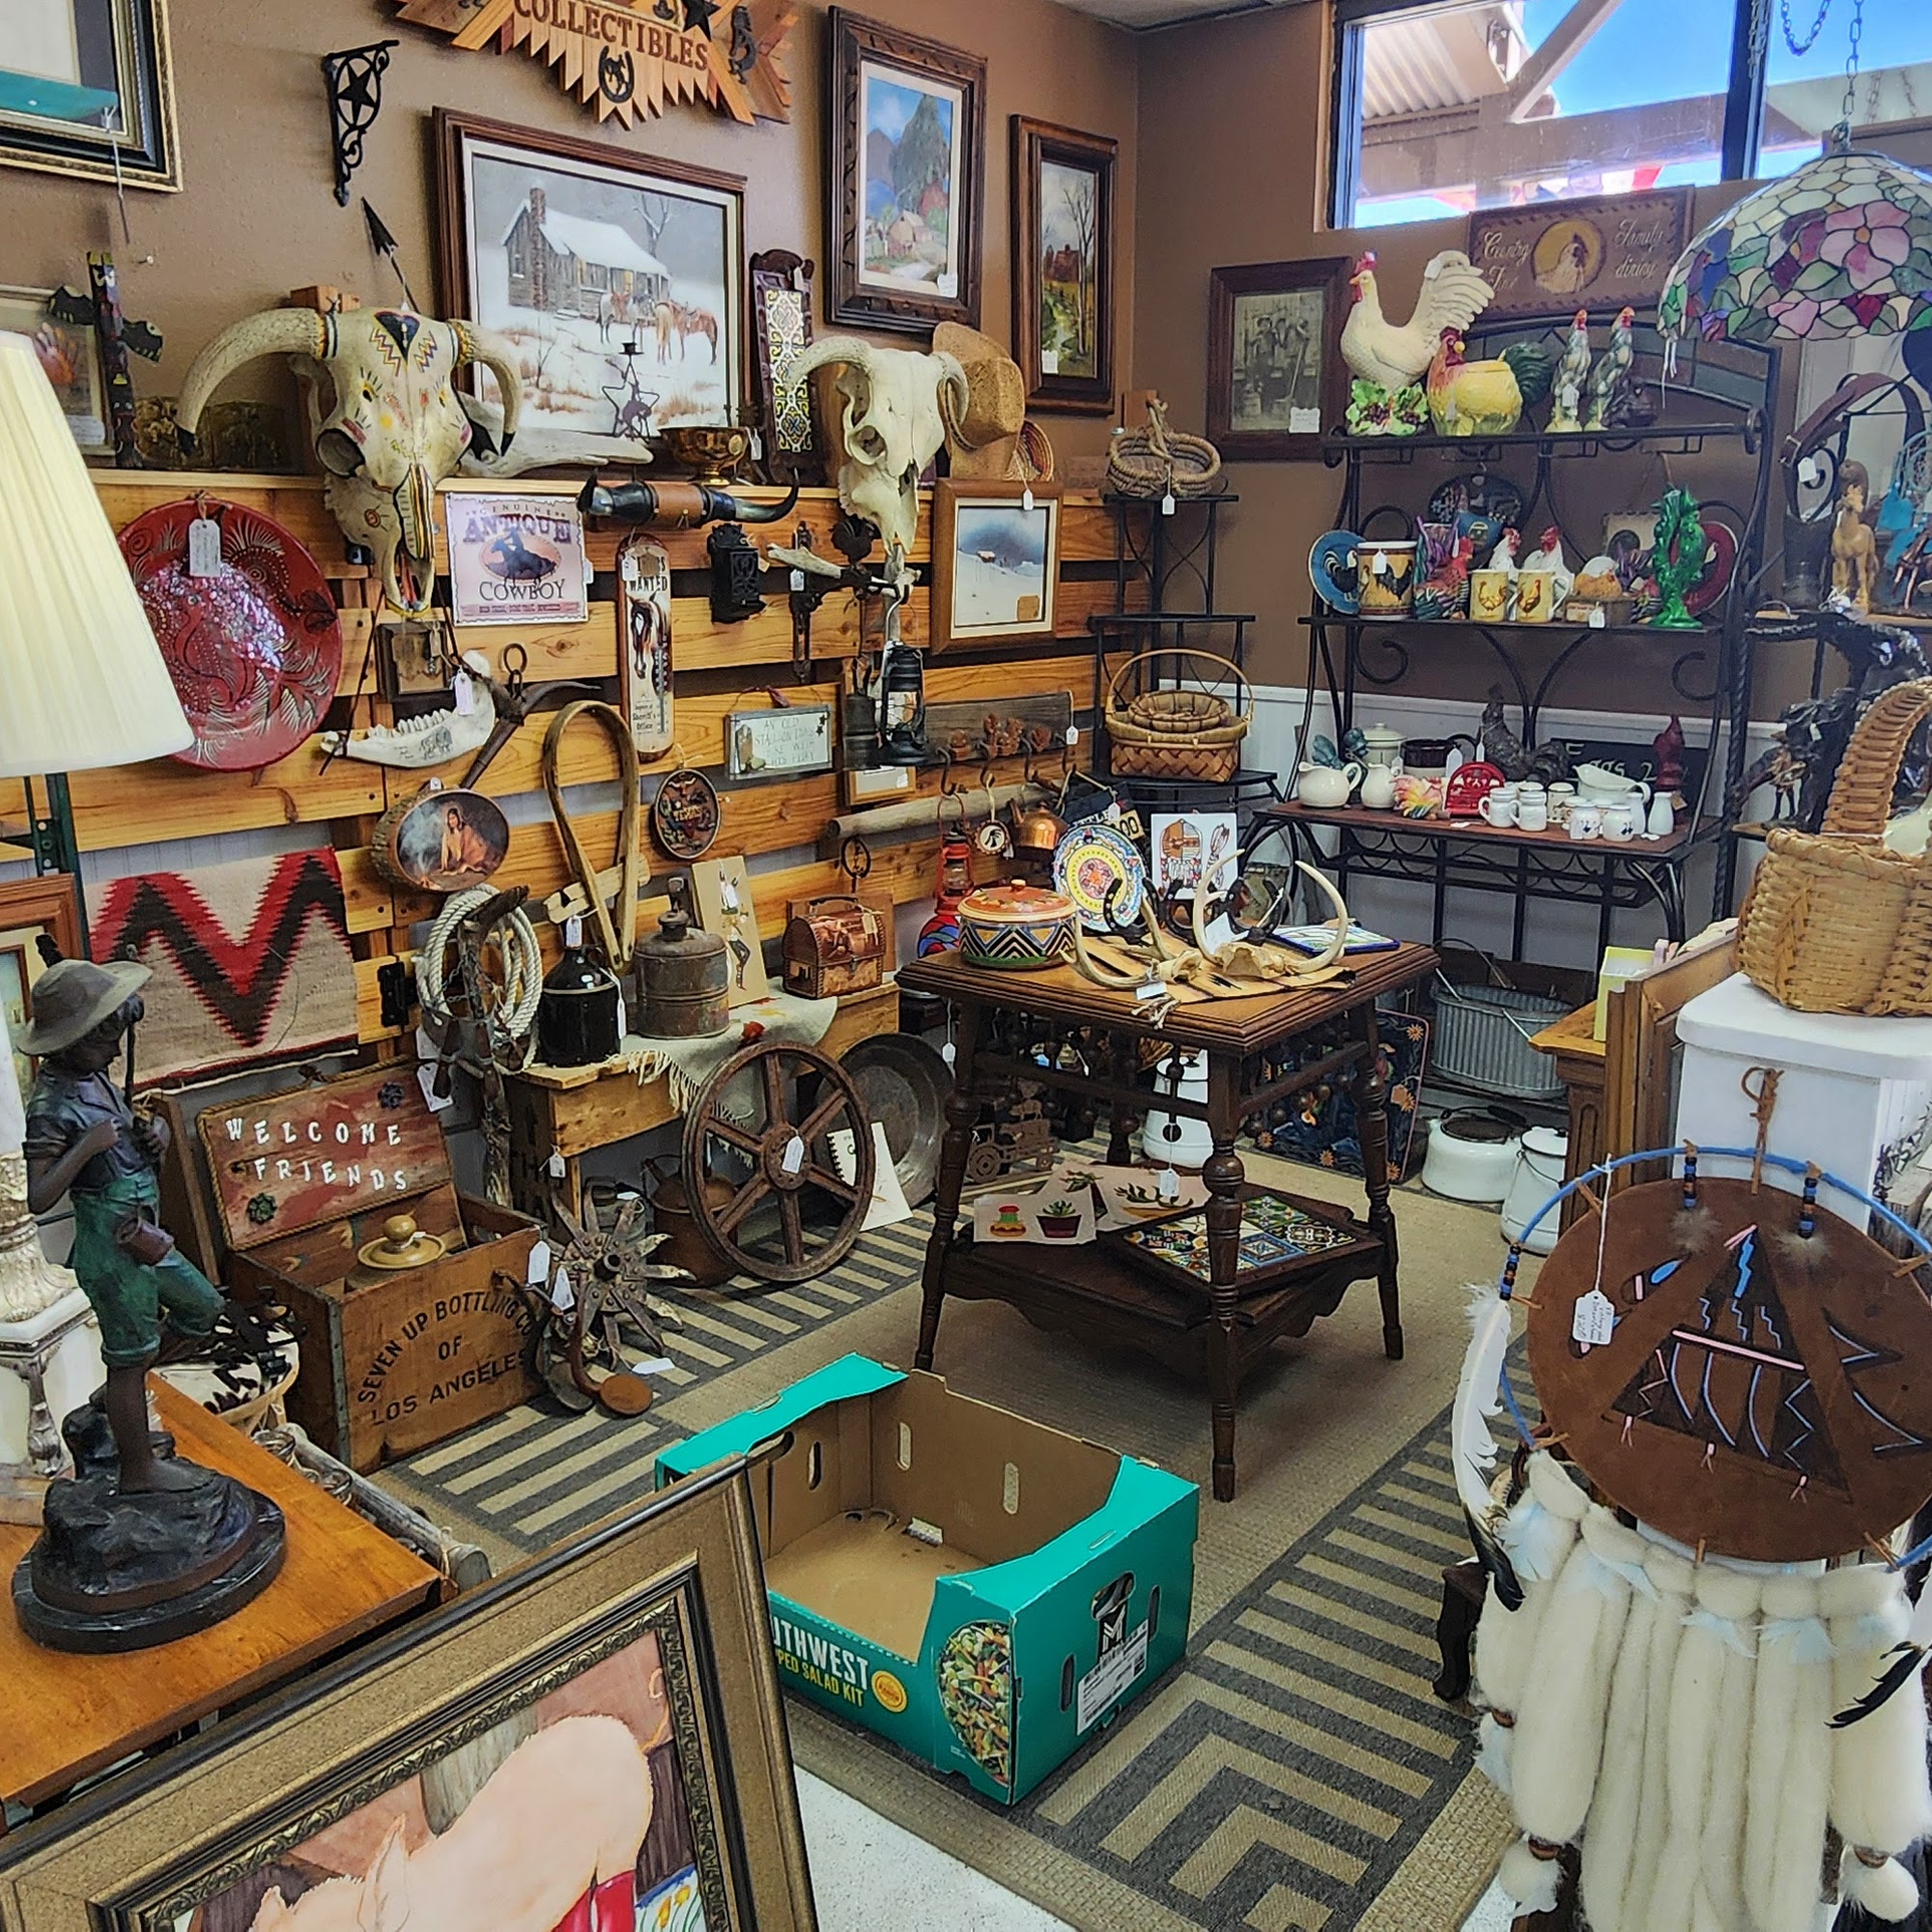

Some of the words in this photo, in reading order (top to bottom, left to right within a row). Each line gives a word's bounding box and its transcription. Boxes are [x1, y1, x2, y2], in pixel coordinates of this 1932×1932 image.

[514, 0, 708, 71] COLLECTIBLES
[463, 513, 572, 544] ANTIQUE
[479, 578, 565, 602] COWBOY
[225, 1117, 402, 1147] WELCOME
[253, 1156, 408, 1191] FRIENDS
[357, 1339, 404, 1404] SEVEN
[401, 1312, 429, 1341] UP
[435, 1291, 519, 1322] BOTTLING
[438, 1334, 463, 1361] OF
[372, 1394, 418, 1426] LOS
[801, 1662, 840, 1695] SALAD
[842, 1682, 865, 1708] KIT
